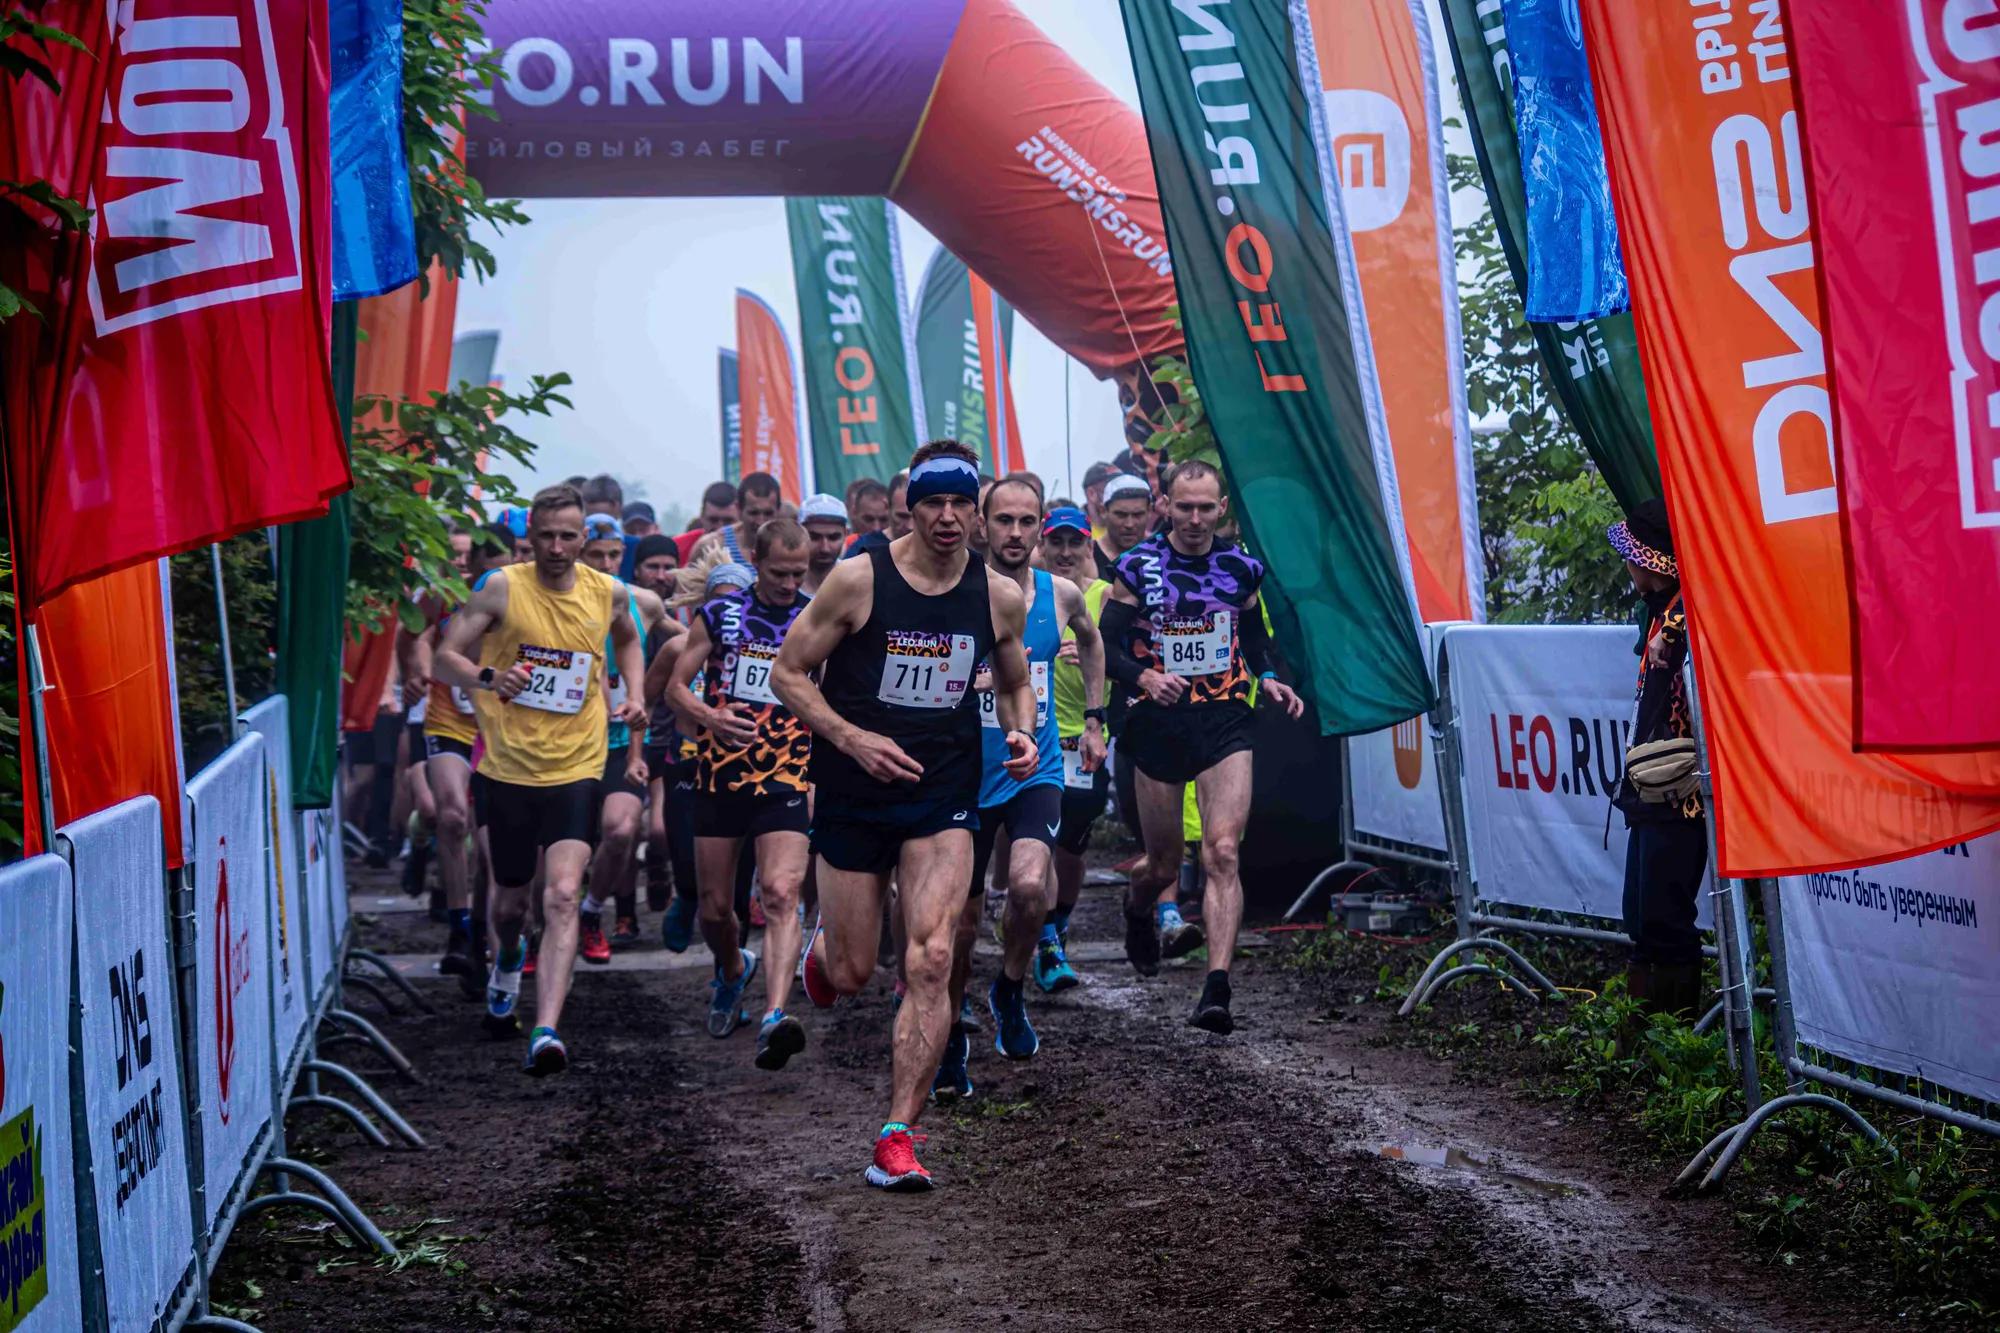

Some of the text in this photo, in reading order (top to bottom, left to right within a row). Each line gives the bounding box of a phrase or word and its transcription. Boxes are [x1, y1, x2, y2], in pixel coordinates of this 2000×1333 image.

[670, 139, 792, 157] ЗАБЕГ
[897, 636, 939, 648] LEO.RUN
[1172, 641, 1206, 663] 845
[894, 663, 934, 692] 711
[1853, 869, 1888, 912] быть
[1889, 885, 1978, 929] уверенным
[108, 948, 152, 1092] DNS
